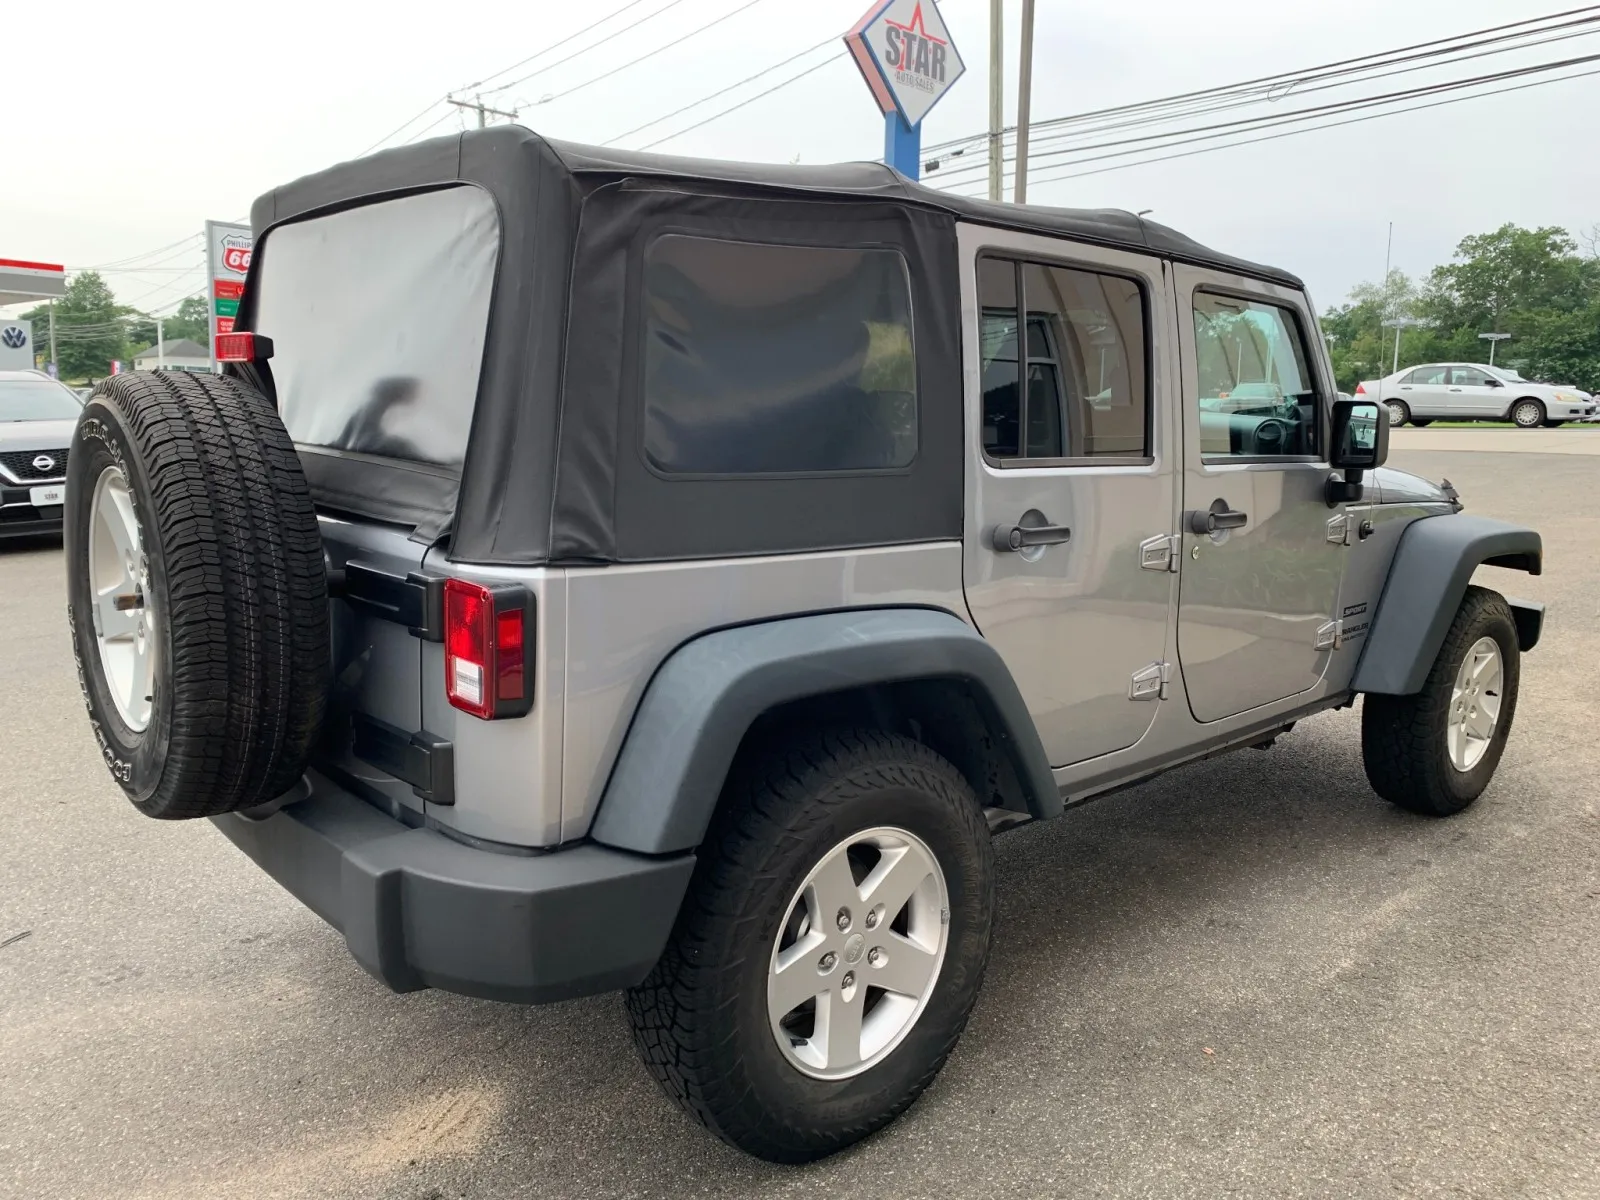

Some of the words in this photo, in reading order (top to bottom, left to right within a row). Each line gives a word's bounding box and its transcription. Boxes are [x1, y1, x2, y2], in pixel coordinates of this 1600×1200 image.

[885, 26, 946, 82] STAR
[896, 70, 914, 84] AUTO
[915, 76, 935, 92] SALES
[227, 239, 252, 249] PHILLIP
[229, 251, 252, 267] 66
[1342, 622, 1368, 635] RANGLER
